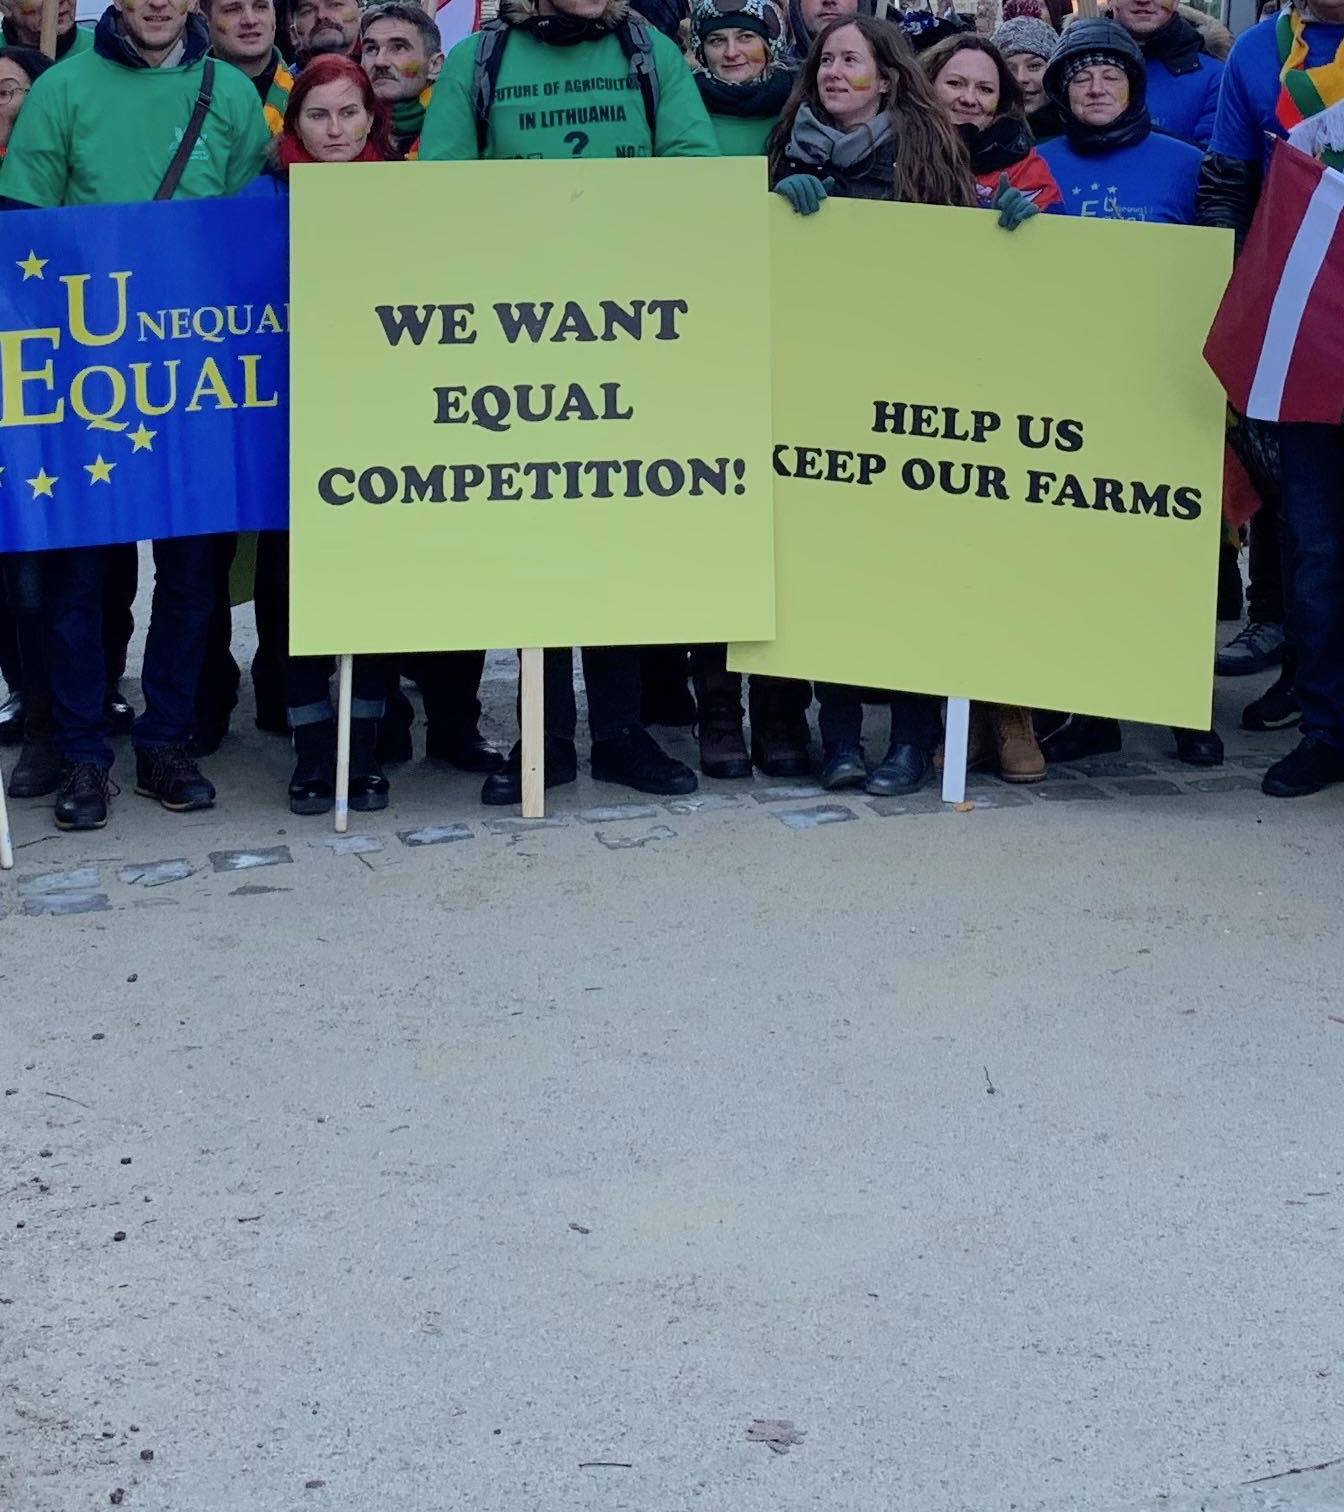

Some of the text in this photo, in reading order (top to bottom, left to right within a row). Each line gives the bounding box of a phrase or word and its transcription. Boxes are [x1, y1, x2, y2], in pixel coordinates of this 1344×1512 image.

[543, 81, 560, 96] OF
[519, 105, 627, 130] IN LITHUANIA
[59, 271, 289, 347] UNEQUA
[375, 299, 688, 346] WE WANT
[433, 382, 634, 432] EQUAL
[871, 400, 1084, 452] HELP US
[318, 458, 746, 506] COMPETITION!
[901, 458, 1010, 500] OUR
[1025, 469, 1202, 521] FARMS
